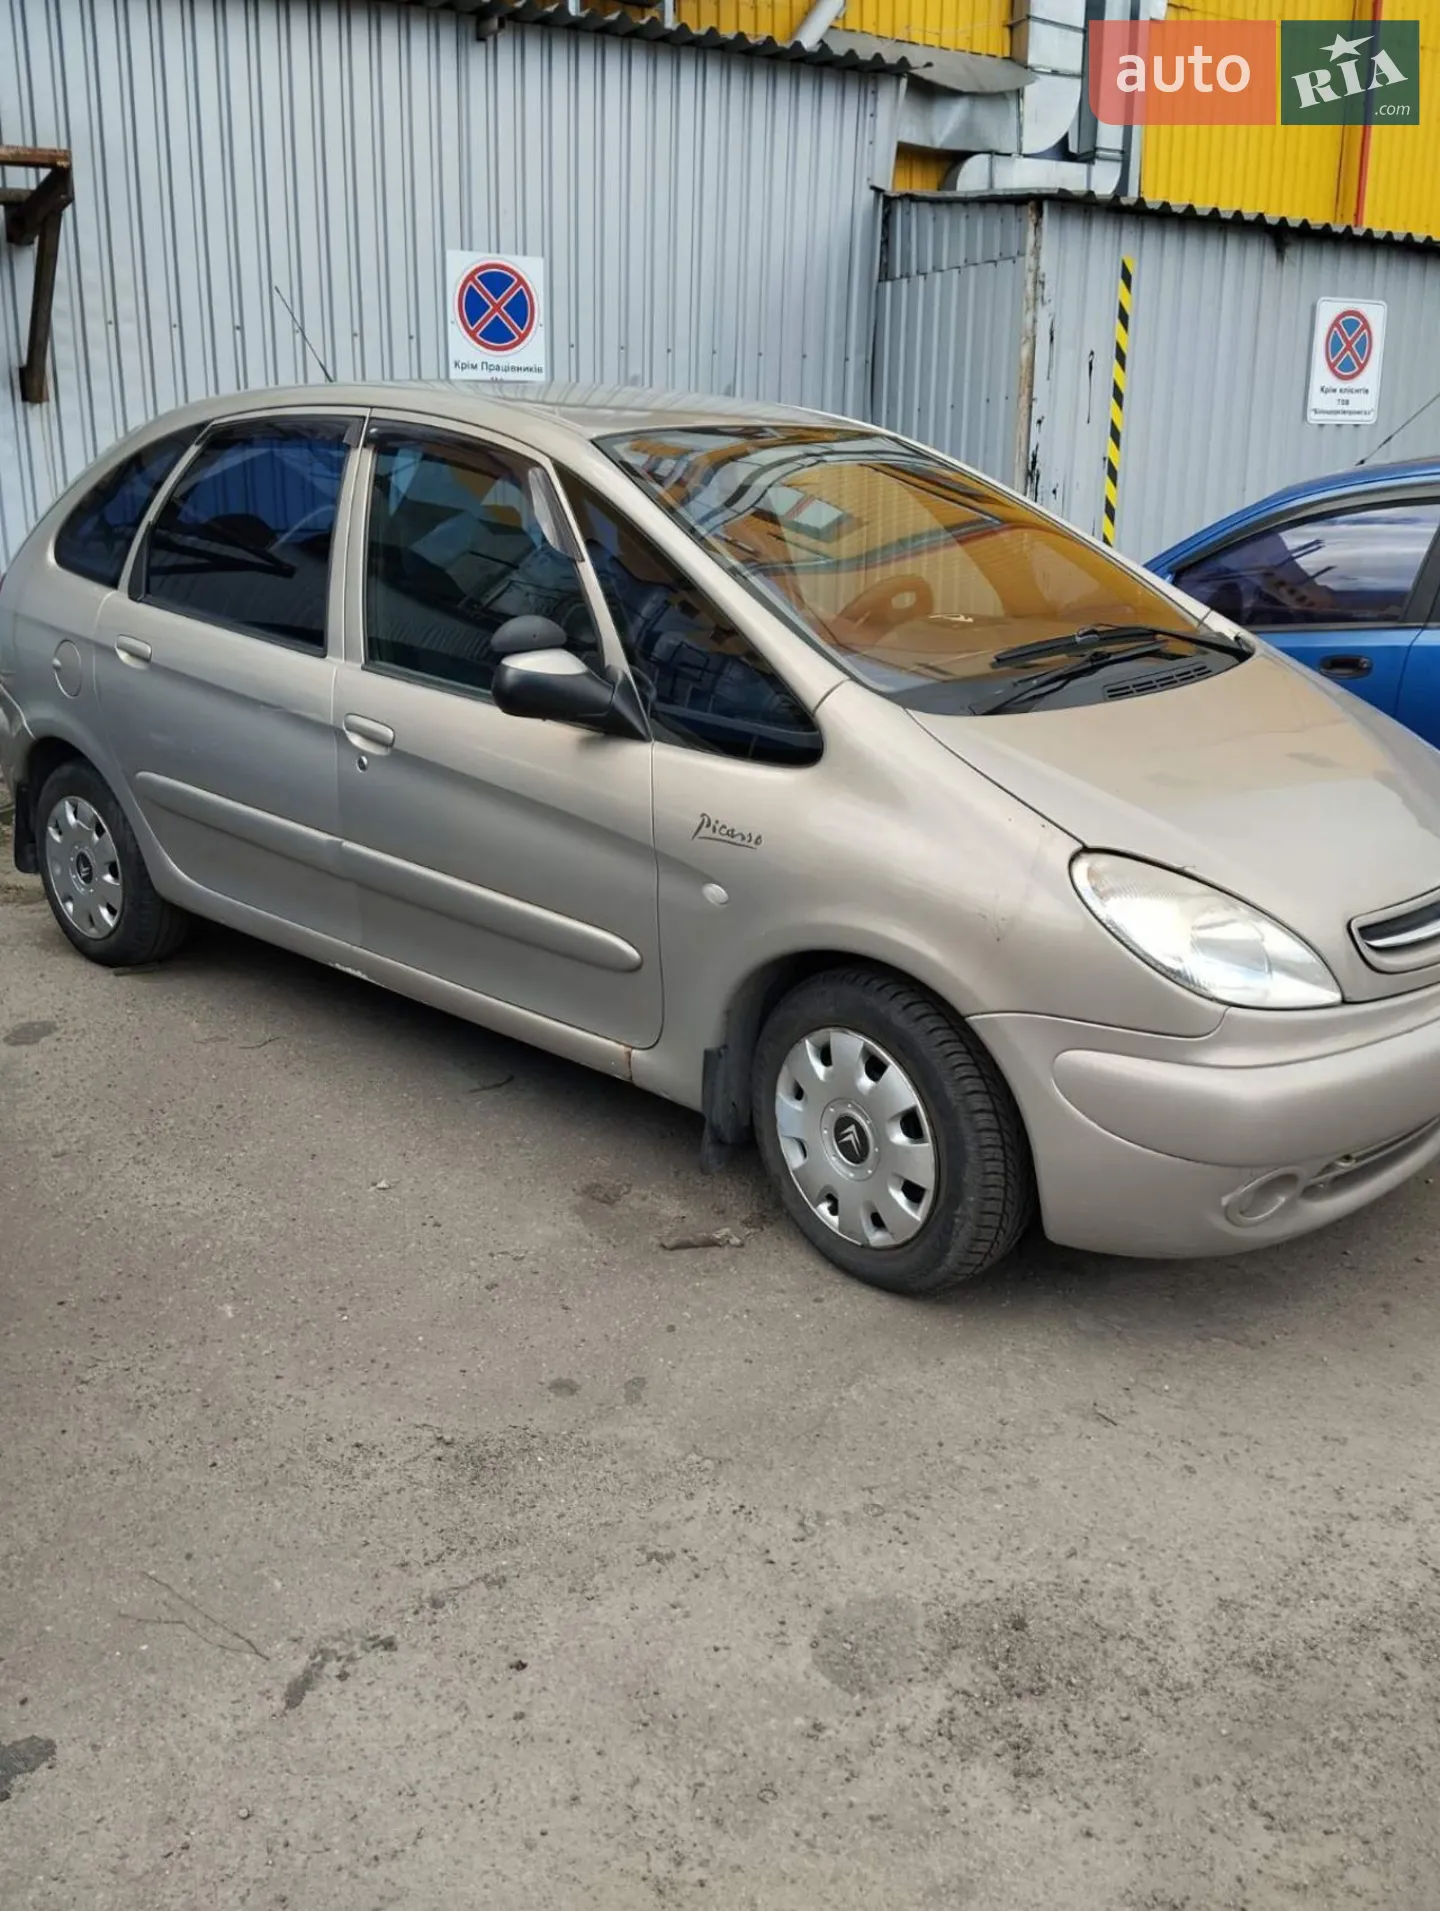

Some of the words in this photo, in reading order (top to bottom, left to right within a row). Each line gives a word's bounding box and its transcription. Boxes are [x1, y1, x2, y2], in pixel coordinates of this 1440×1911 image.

[453, 360, 479, 371] Крім
[480, 361, 545, 374] Працівників
[691, 812, 763, 848] Picasso
